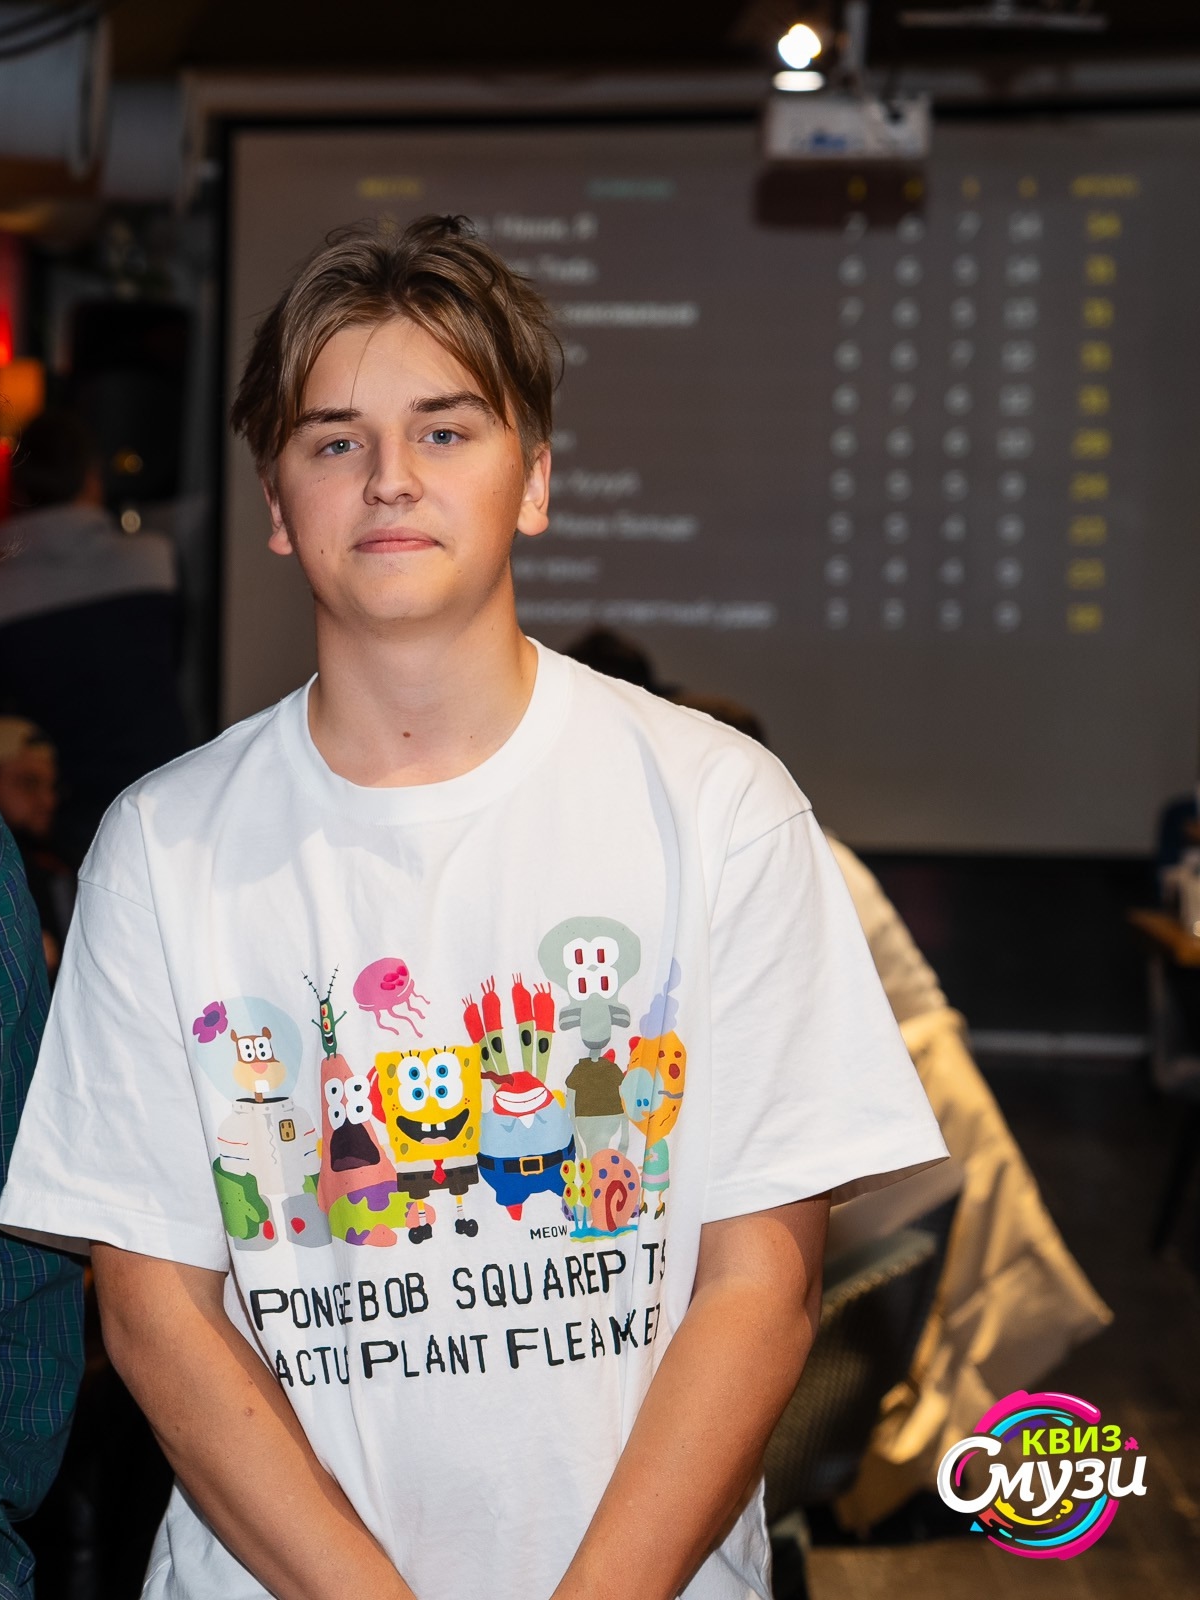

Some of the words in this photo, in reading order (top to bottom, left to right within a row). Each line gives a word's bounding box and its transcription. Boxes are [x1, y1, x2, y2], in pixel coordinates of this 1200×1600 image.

[530, 1225, 568, 1240] MEOW
[250, 1272, 429, 1331] PONGEBOB
[276, 1345, 350, 1388] ACTU
[361, 1334, 488, 1379] PLANT
